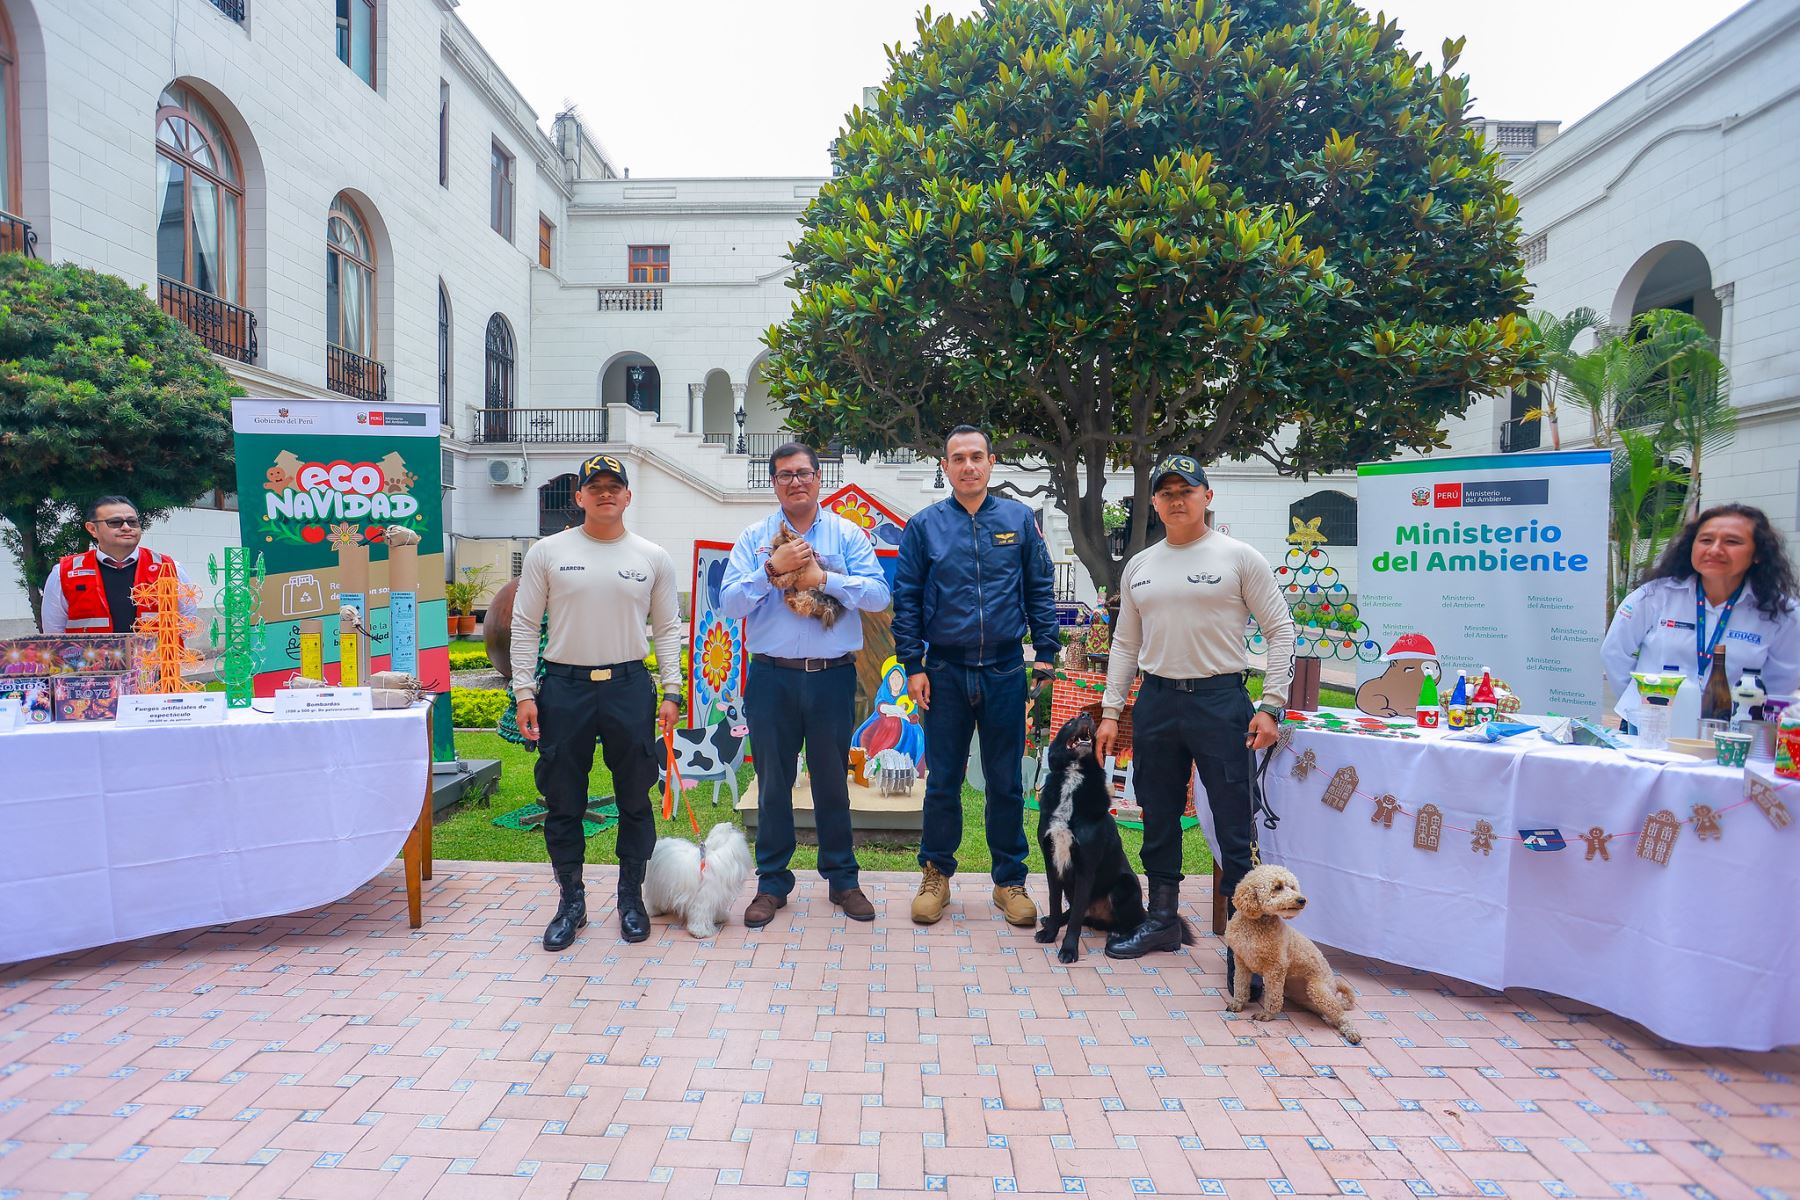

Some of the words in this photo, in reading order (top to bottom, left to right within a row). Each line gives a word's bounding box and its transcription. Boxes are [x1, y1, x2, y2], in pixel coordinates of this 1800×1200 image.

[254, 417, 286, 425] Gobierno
[585, 455, 621, 474] K9
[1165, 457, 1195, 474] K9
[301, 464, 380, 495] eco
[1437, 490, 1459, 500] PERÚ
[266, 488, 419, 520] NAVIDAD
[1396, 519, 1562, 545] Ministerio
[1372, 551, 1418, 573] del
[1426, 548, 1589, 572] Ambiente
[1550, 627, 1588, 635] Ministerio
[1550, 634, 1562, 642] del
[1563, 634, 1599, 643] Ambiente
[1526, 656, 1561, 664] Ministerio
[1538, 664, 1572, 672] Ambiente
[1550, 688, 1585, 697] Ministerio
[1549, 696, 1561, 704] del
[1562, 697, 1596, 706] Ambiente
